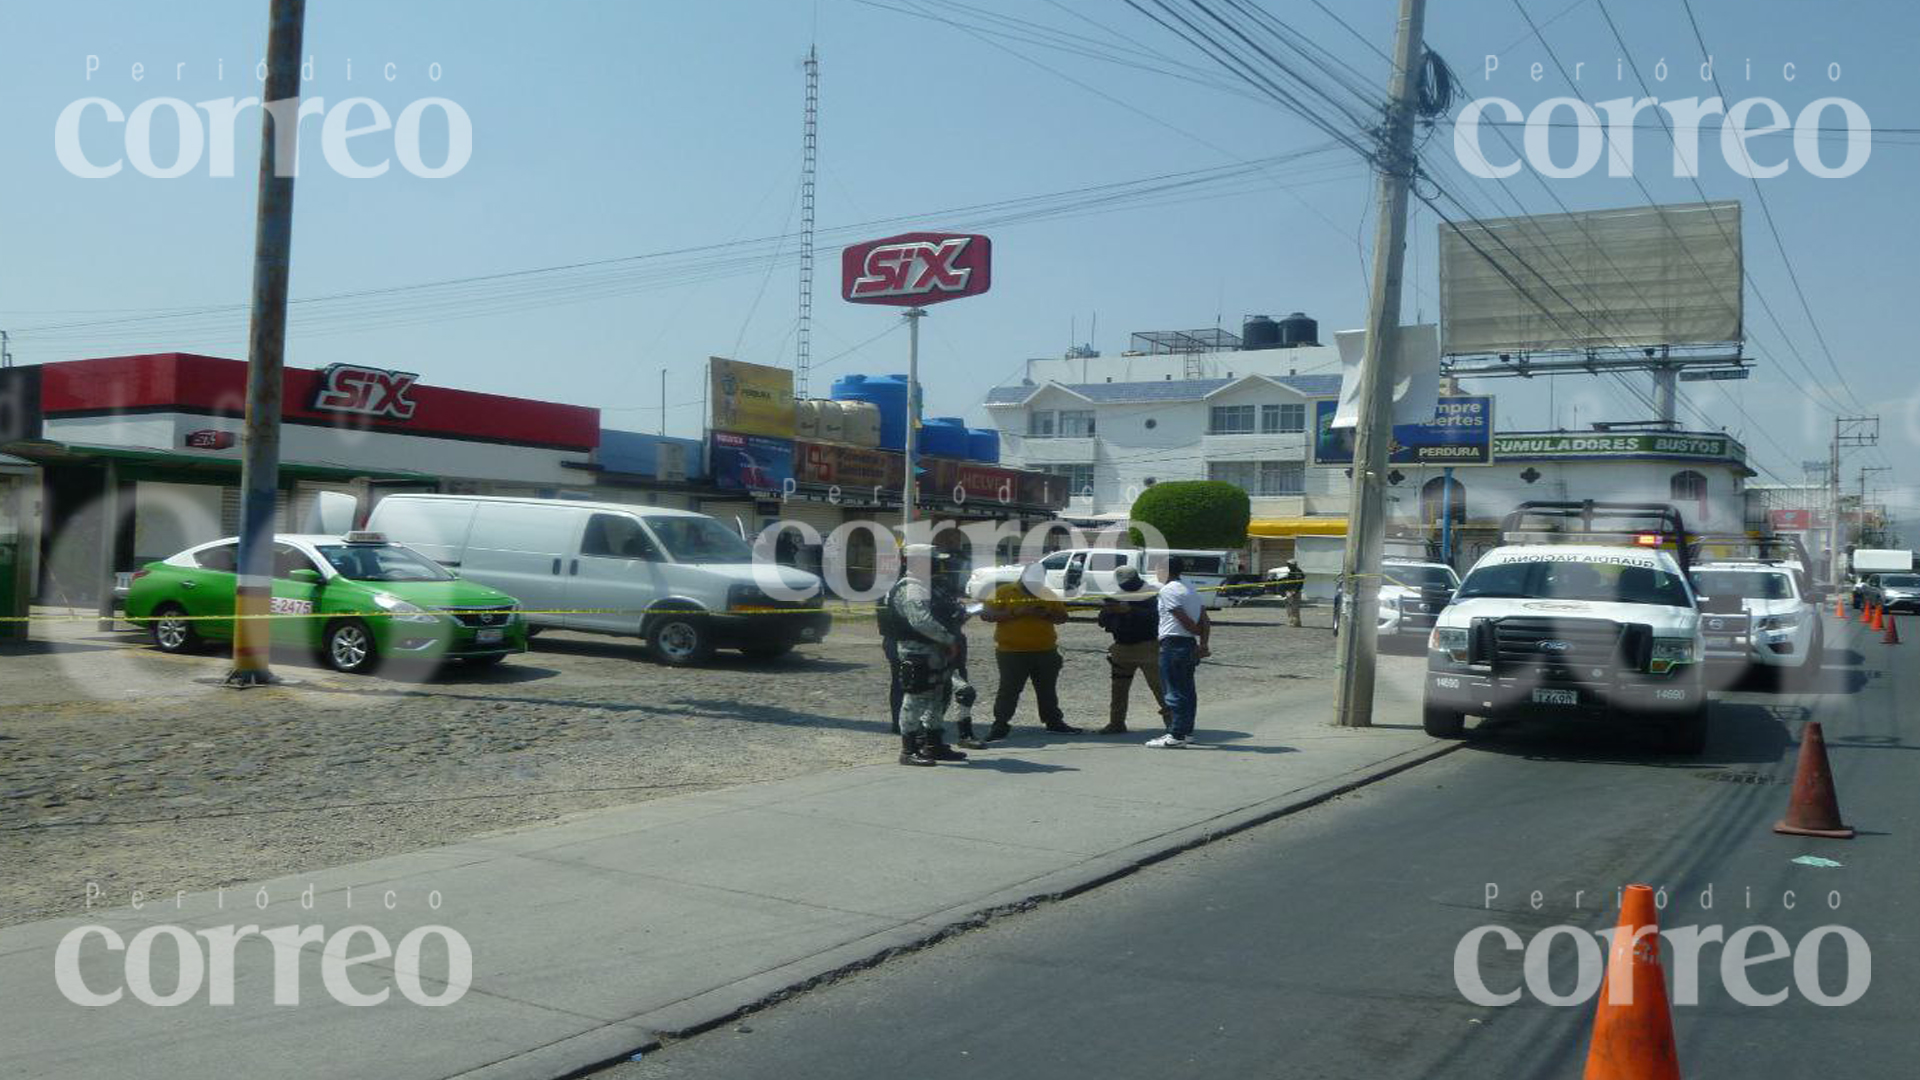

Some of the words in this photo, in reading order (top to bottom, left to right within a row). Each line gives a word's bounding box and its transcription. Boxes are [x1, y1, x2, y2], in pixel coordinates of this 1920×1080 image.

[1418, 414, 1483, 426] uertes
[1654, 437, 1720, 453] BUSTOS
[1418, 447, 1480, 456] PERDURA
[963, 472, 1008, 490] HELVE
[1655, 689, 1685, 700] 14690
